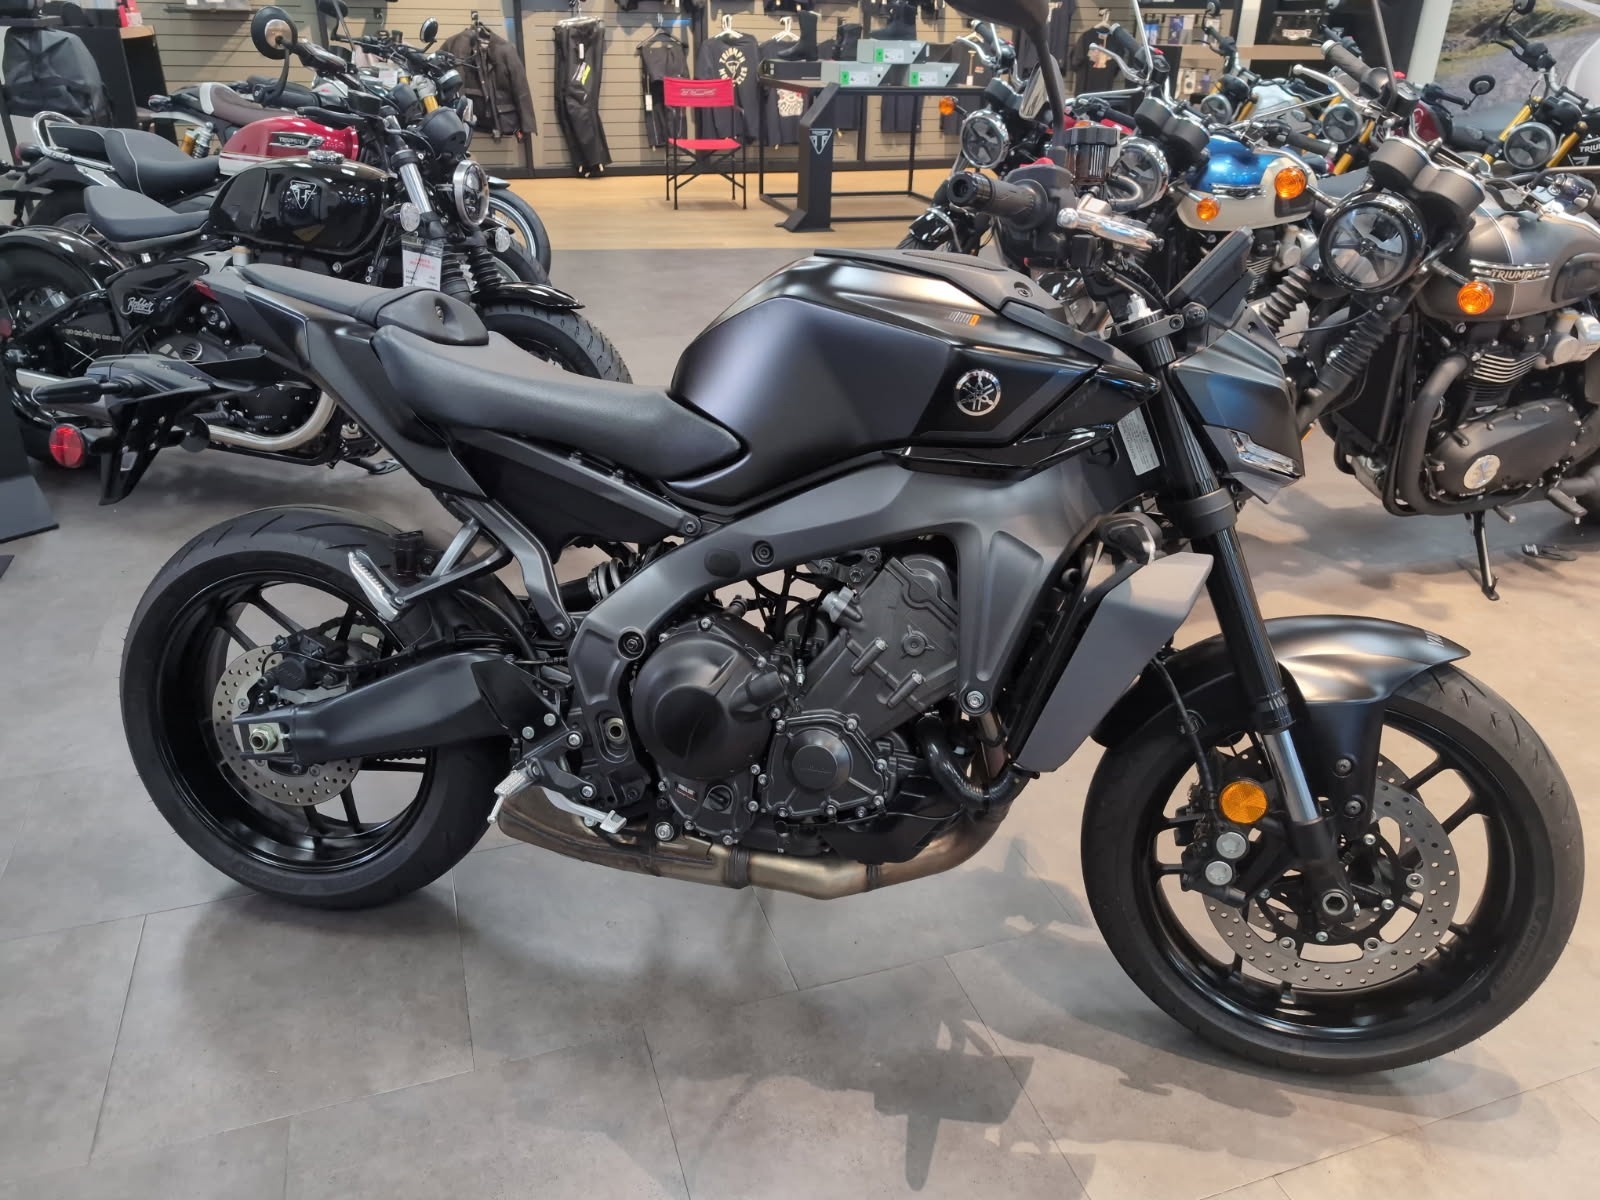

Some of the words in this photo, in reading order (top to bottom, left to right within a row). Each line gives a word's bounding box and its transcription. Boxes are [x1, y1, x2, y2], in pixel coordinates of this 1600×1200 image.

[719, 47, 746, 64] TRIUMPH
[1579, 143, 1600, 154] TRIU
[1490, 268, 1538, 283] TRIUMPH
